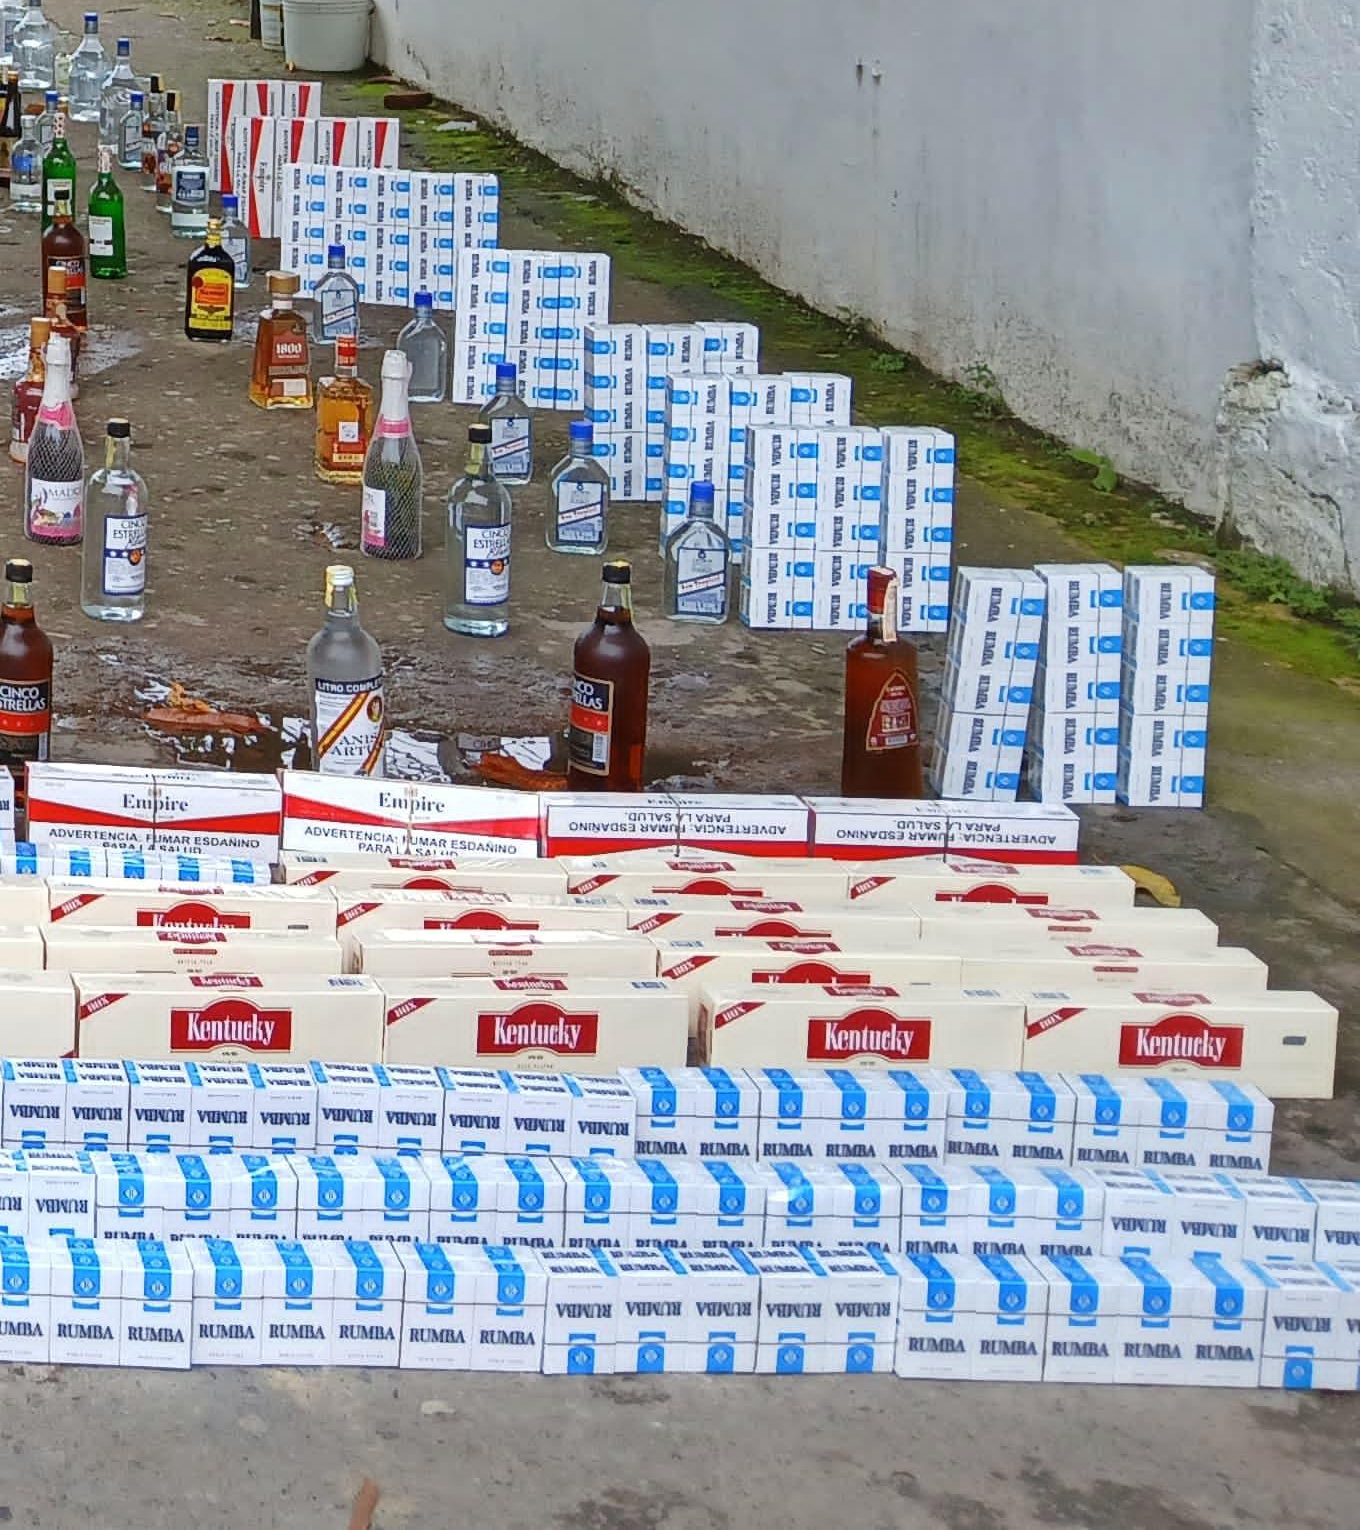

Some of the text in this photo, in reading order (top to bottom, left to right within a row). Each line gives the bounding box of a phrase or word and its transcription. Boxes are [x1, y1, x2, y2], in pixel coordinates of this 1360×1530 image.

[276, 343, 302, 354] 1800
[0, 686, 39, 699] CINCO
[122, 794, 188, 823] Empire
[378, 792, 446, 823] Empire
[697, 813, 731, 822] PARA
[639, 823, 680, 834] FUMAR
[682, 823, 786, 836] ADVERTENCIA:
[969, 821, 1001, 832] PARA
[49, 828, 142, 843] ADVERTENCIA:
[146, 833, 191, 846] FUMAR
[304, 825, 400, 845] ADVERTENCIA:
[402, 834, 448, 849] FUMAR
[907, 830, 956, 841] FUMAR
[358, 842, 391, 855] PARA
[186, 1009, 277, 1046] Kentucky
[494, 1014, 582, 1049] Kentucky
[823, 1021, 915, 1057] Kentucky
[1136, 1028, 1227, 1062] Kentucky
[514, 1118, 564, 1132] RUMBA
[826, 1144, 875, 1157] RUMBA
[1144, 1151, 1195, 1166] RUMBA
[58, 1324, 113, 1339] RUMBA
[192, 1324, 254, 1339] RUMBA
[909, 1337, 965, 1352] RUMBA
[1125, 1343, 1180, 1358] RUMBA
